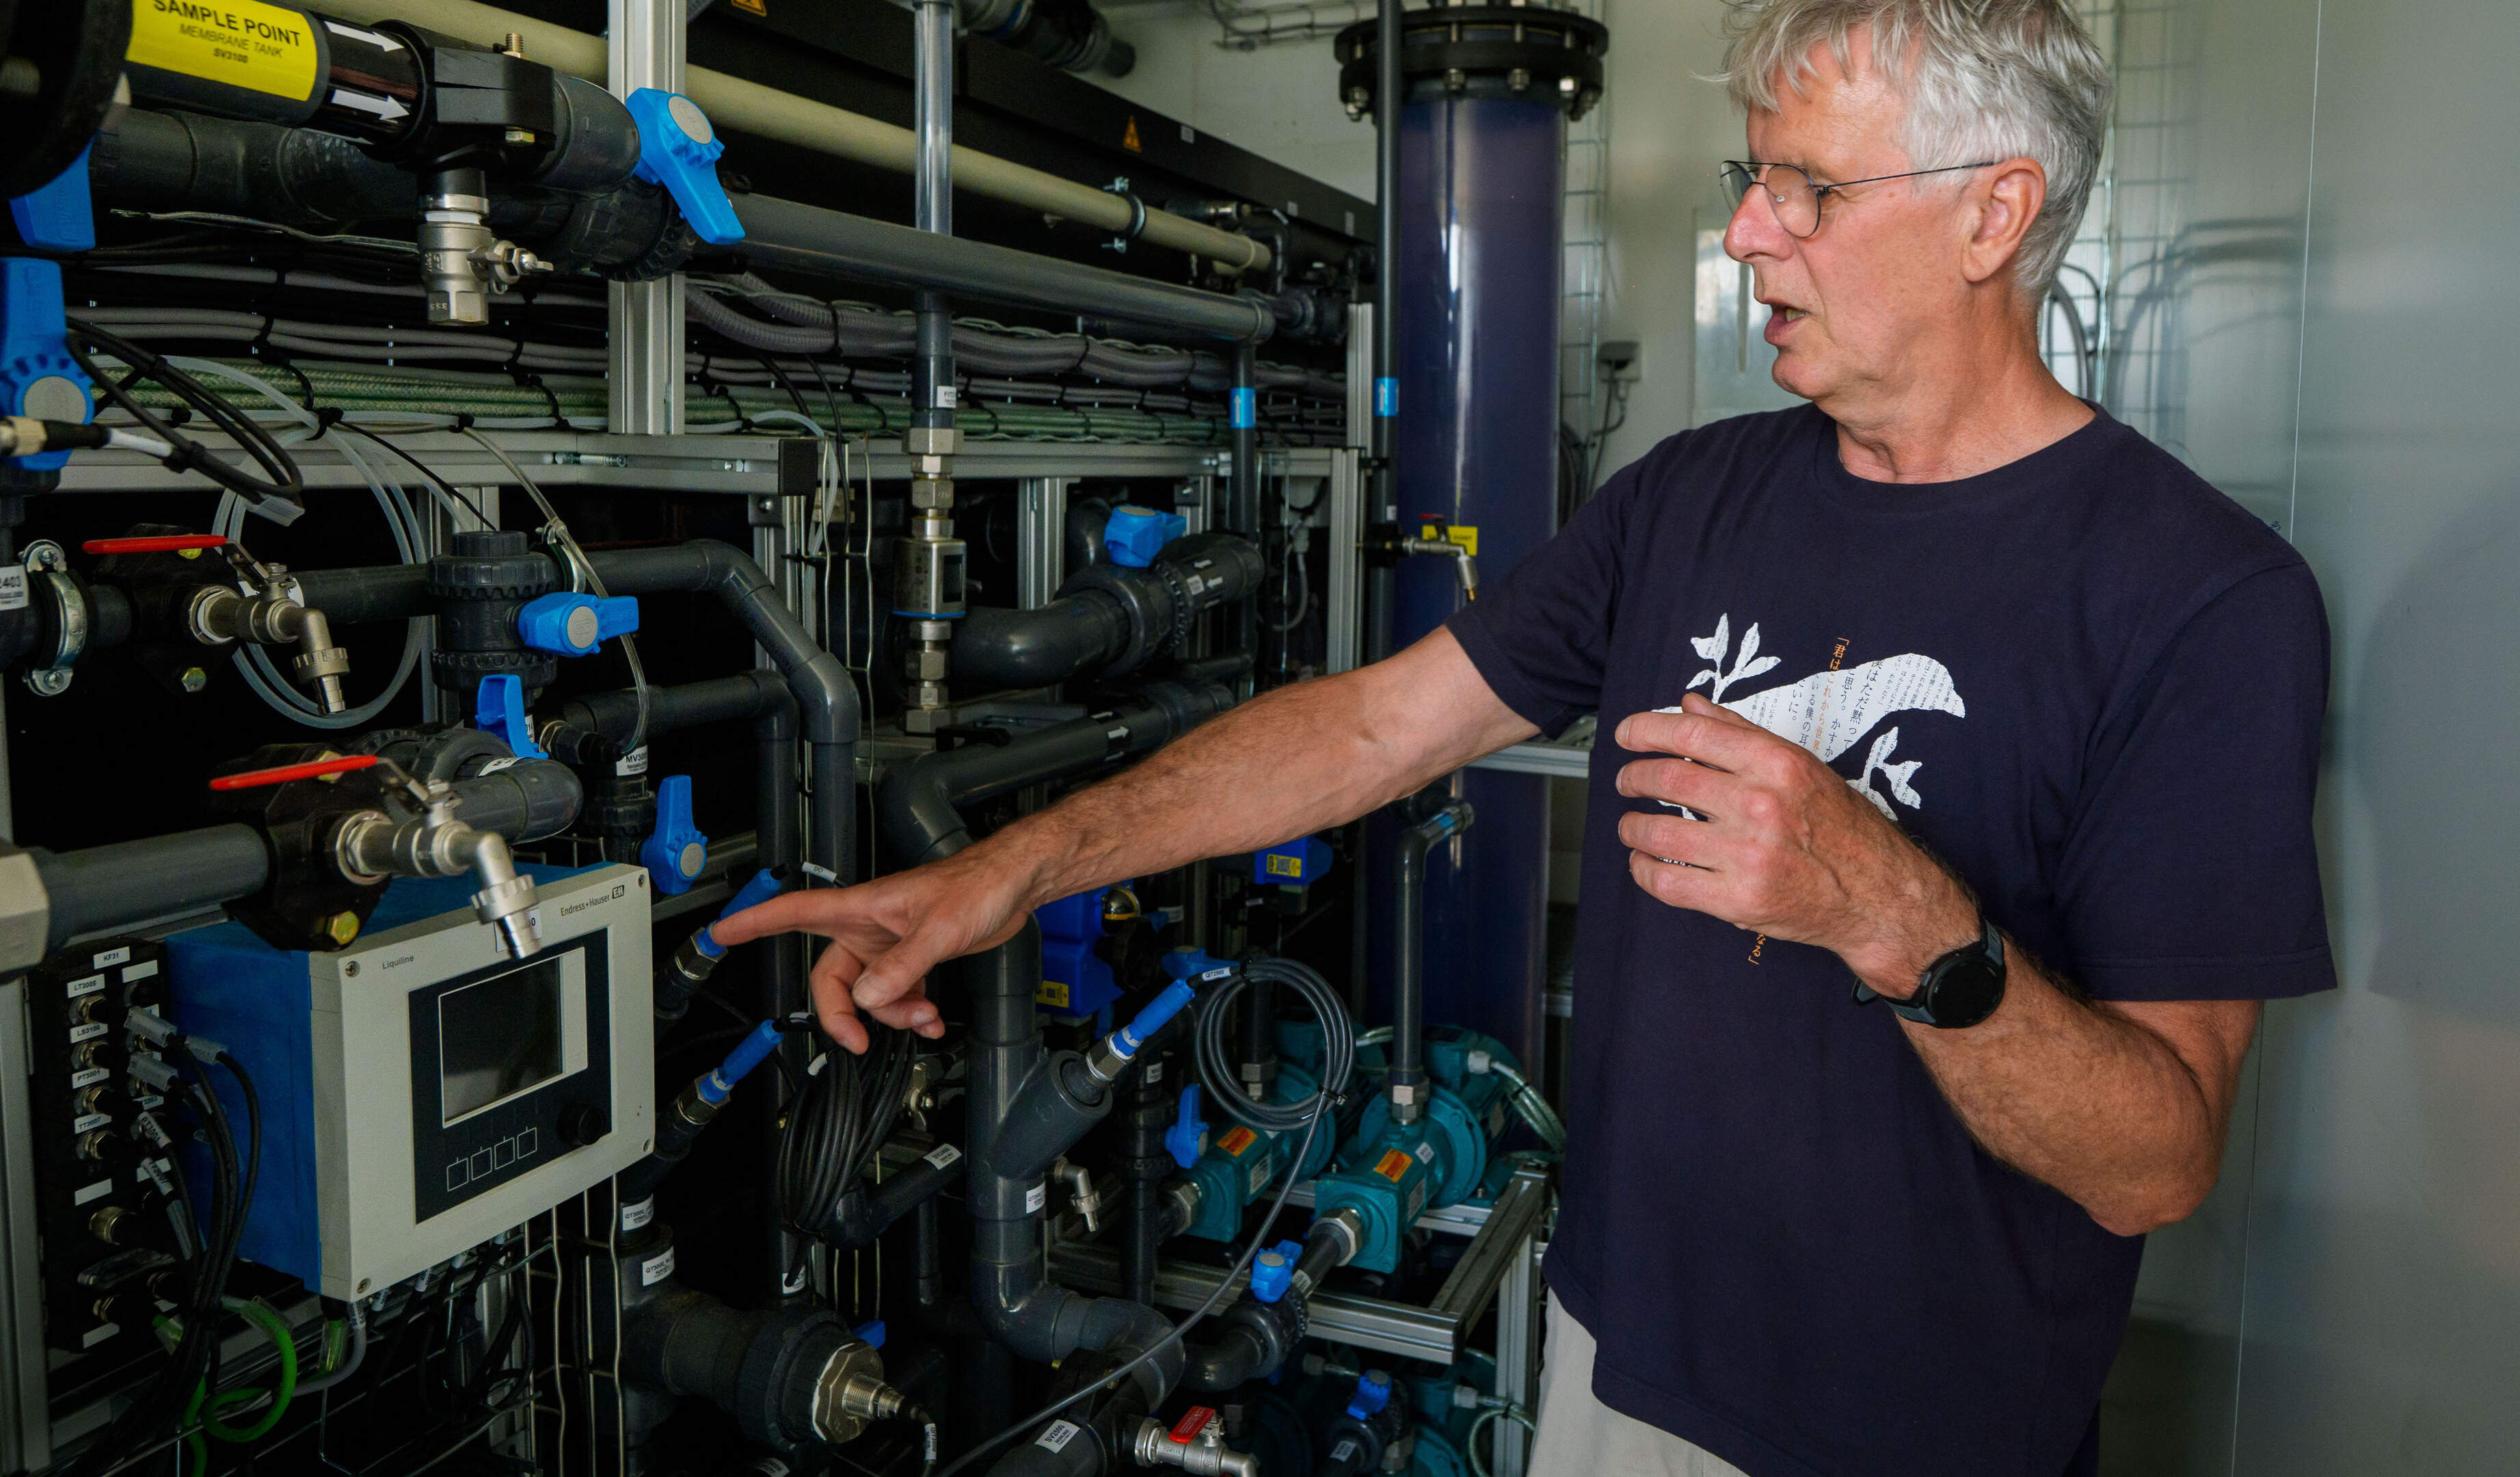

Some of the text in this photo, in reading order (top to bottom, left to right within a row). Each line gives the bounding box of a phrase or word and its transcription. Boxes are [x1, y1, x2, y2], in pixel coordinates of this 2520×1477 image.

[154, 0, 300, 46] SAMPLE POINT
[180, 24, 283, 59] MEMBRANE TANK
[561, 894, 610, 916] Endress+Hauser
[103, 953, 120, 961] KF31
[382, 955, 414, 970] Liquiline
